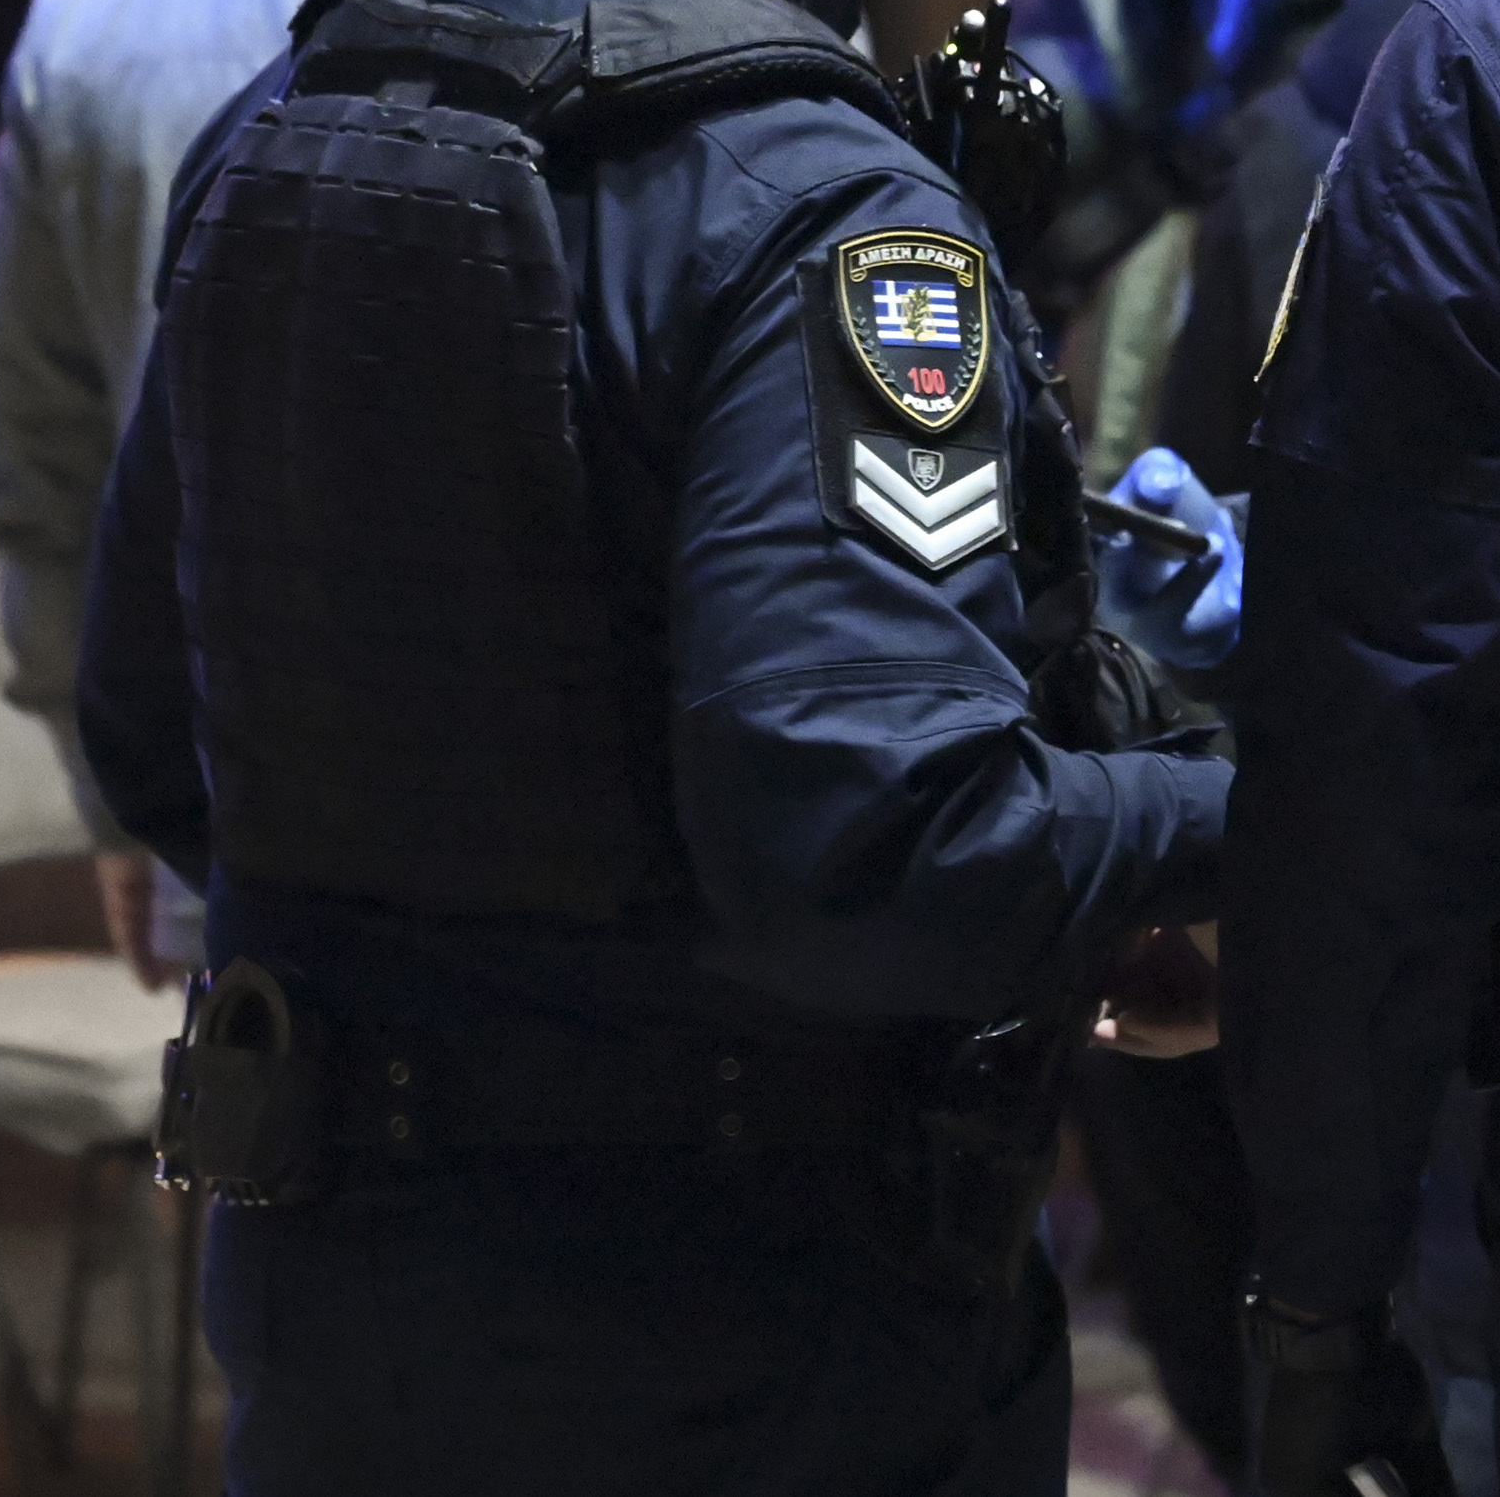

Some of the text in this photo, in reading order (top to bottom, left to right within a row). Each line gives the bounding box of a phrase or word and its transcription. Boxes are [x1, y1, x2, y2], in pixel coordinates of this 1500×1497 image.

[858, 246, 967, 271] ΑΜΕΣΗ ΔΡΑΣΗ
[907, 367, 946, 395] 100
[902, 392, 957, 413] POLICE
